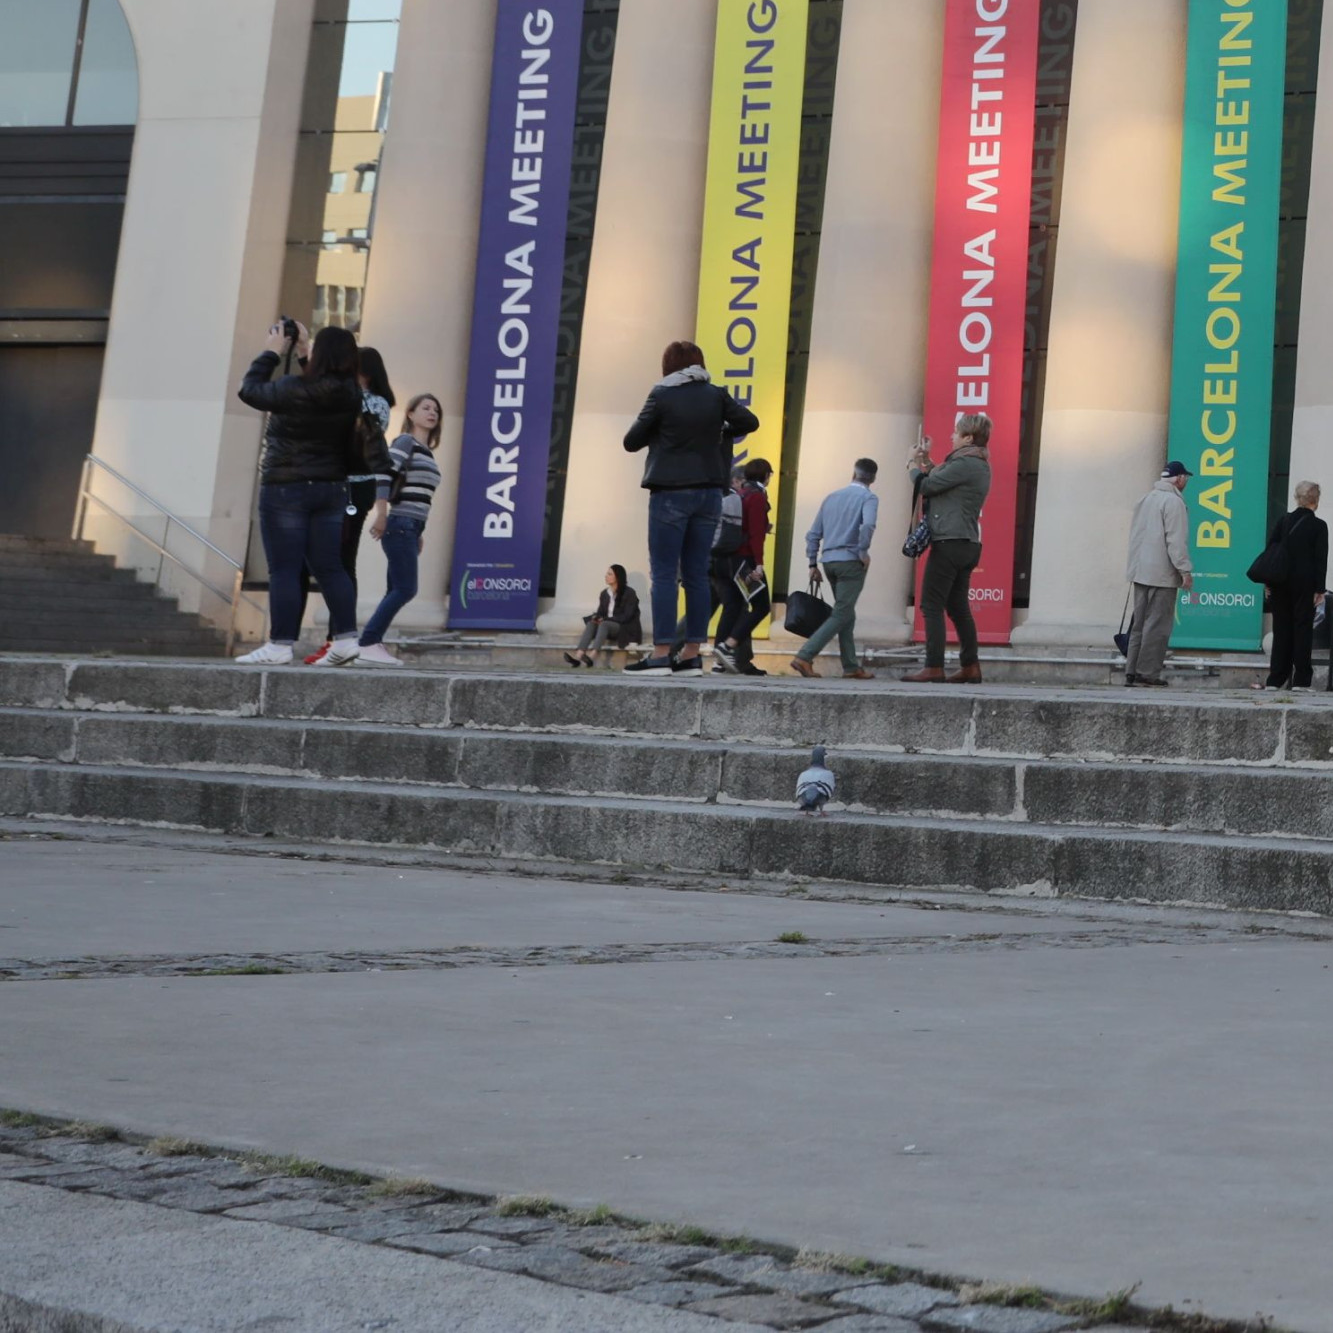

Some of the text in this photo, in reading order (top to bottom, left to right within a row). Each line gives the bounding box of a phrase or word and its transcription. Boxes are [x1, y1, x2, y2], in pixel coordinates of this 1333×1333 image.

[507, 8, 554, 227] MEETING
[483, 239, 536, 538] BARCELONA
[724, 236, 764, 469] ELONA
[954, 228, 998, 428] ELONA
[1197, 222, 1244, 548] BARCELONA
[968, 588, 1004, 602] SORCI
